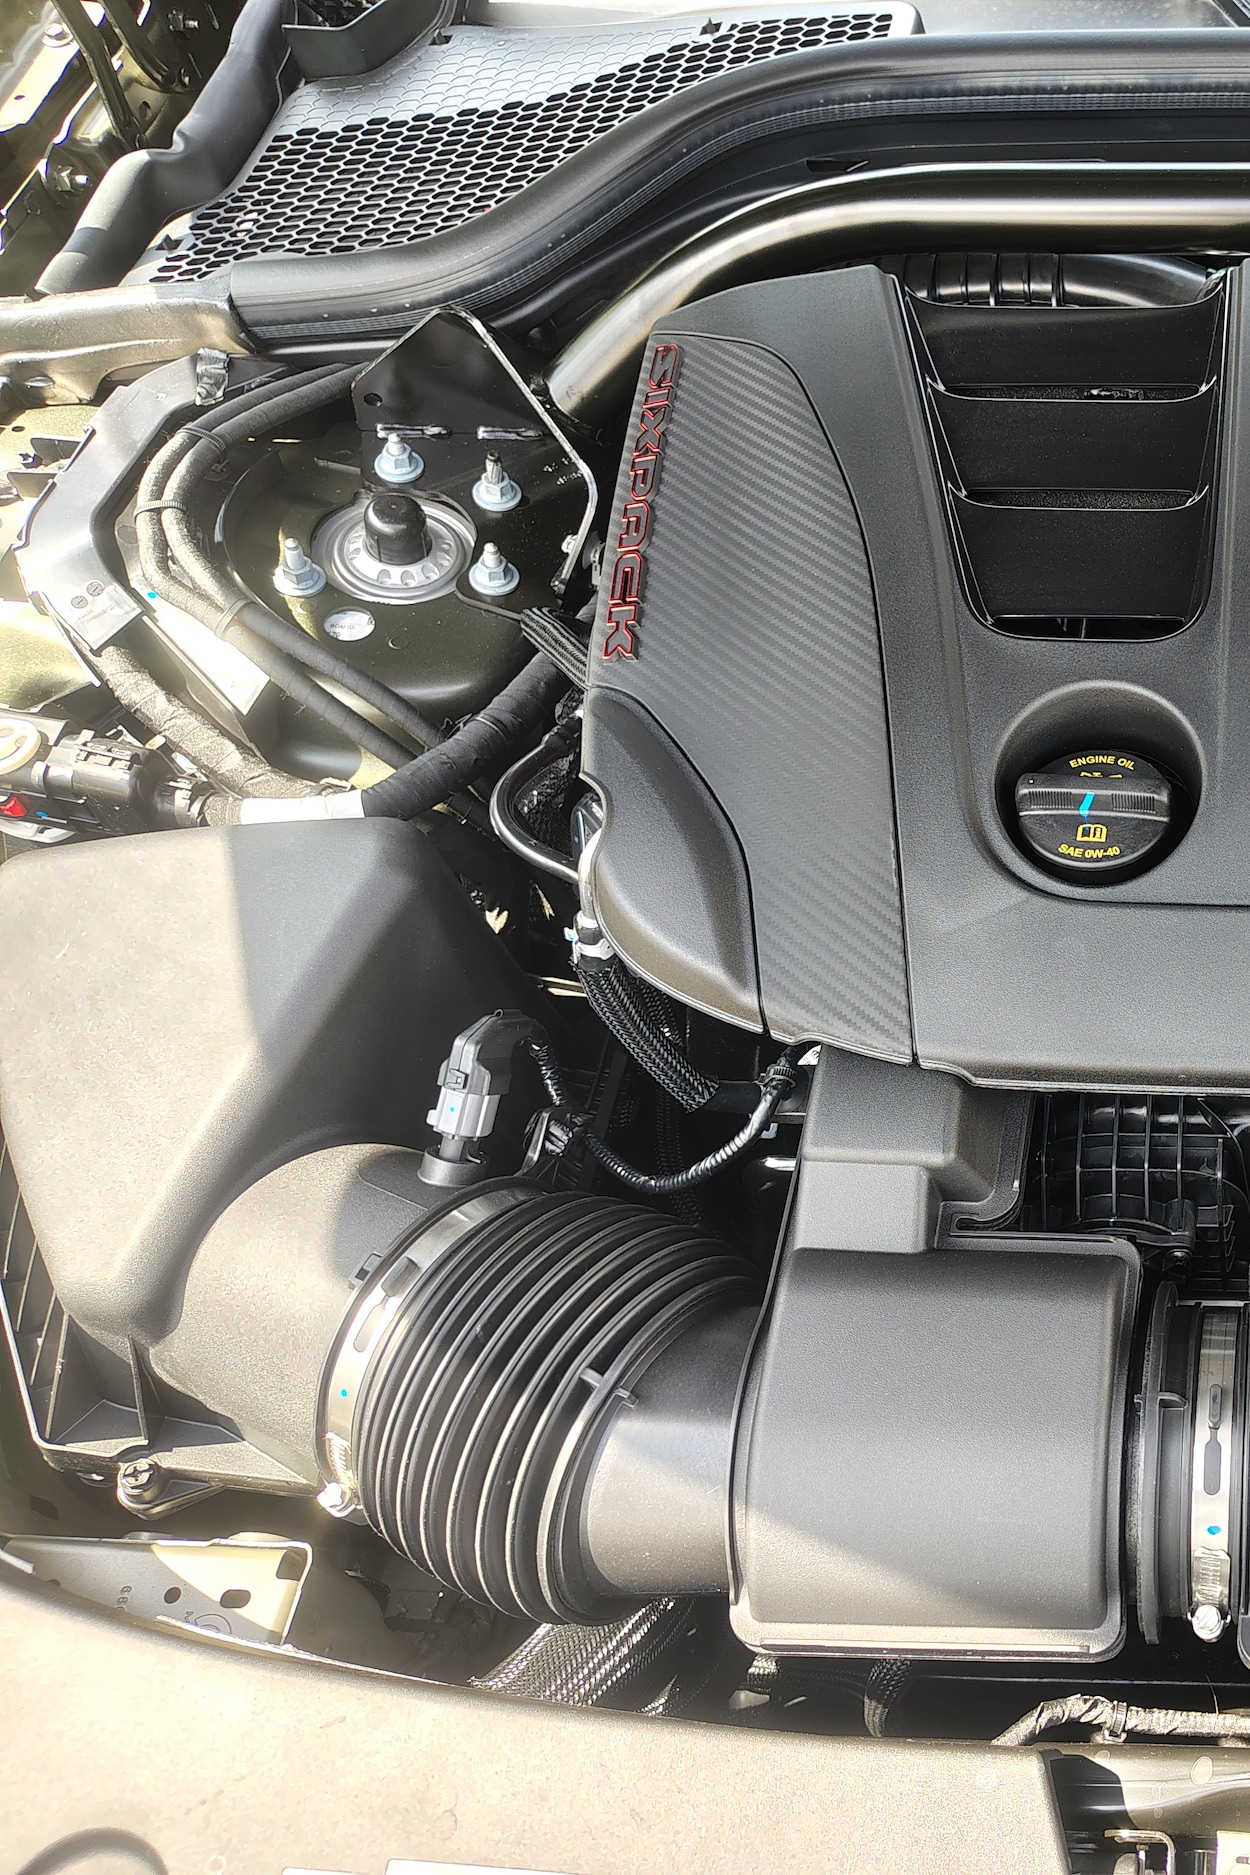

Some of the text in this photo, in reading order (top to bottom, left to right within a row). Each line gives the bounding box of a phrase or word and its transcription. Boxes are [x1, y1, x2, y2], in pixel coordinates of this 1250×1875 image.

[601, 343, 681, 662] SIXPACK
[1068, 755, 1136, 771] ENGINE OIL
[1058, 843, 1121, 858] SAE 0W-40
